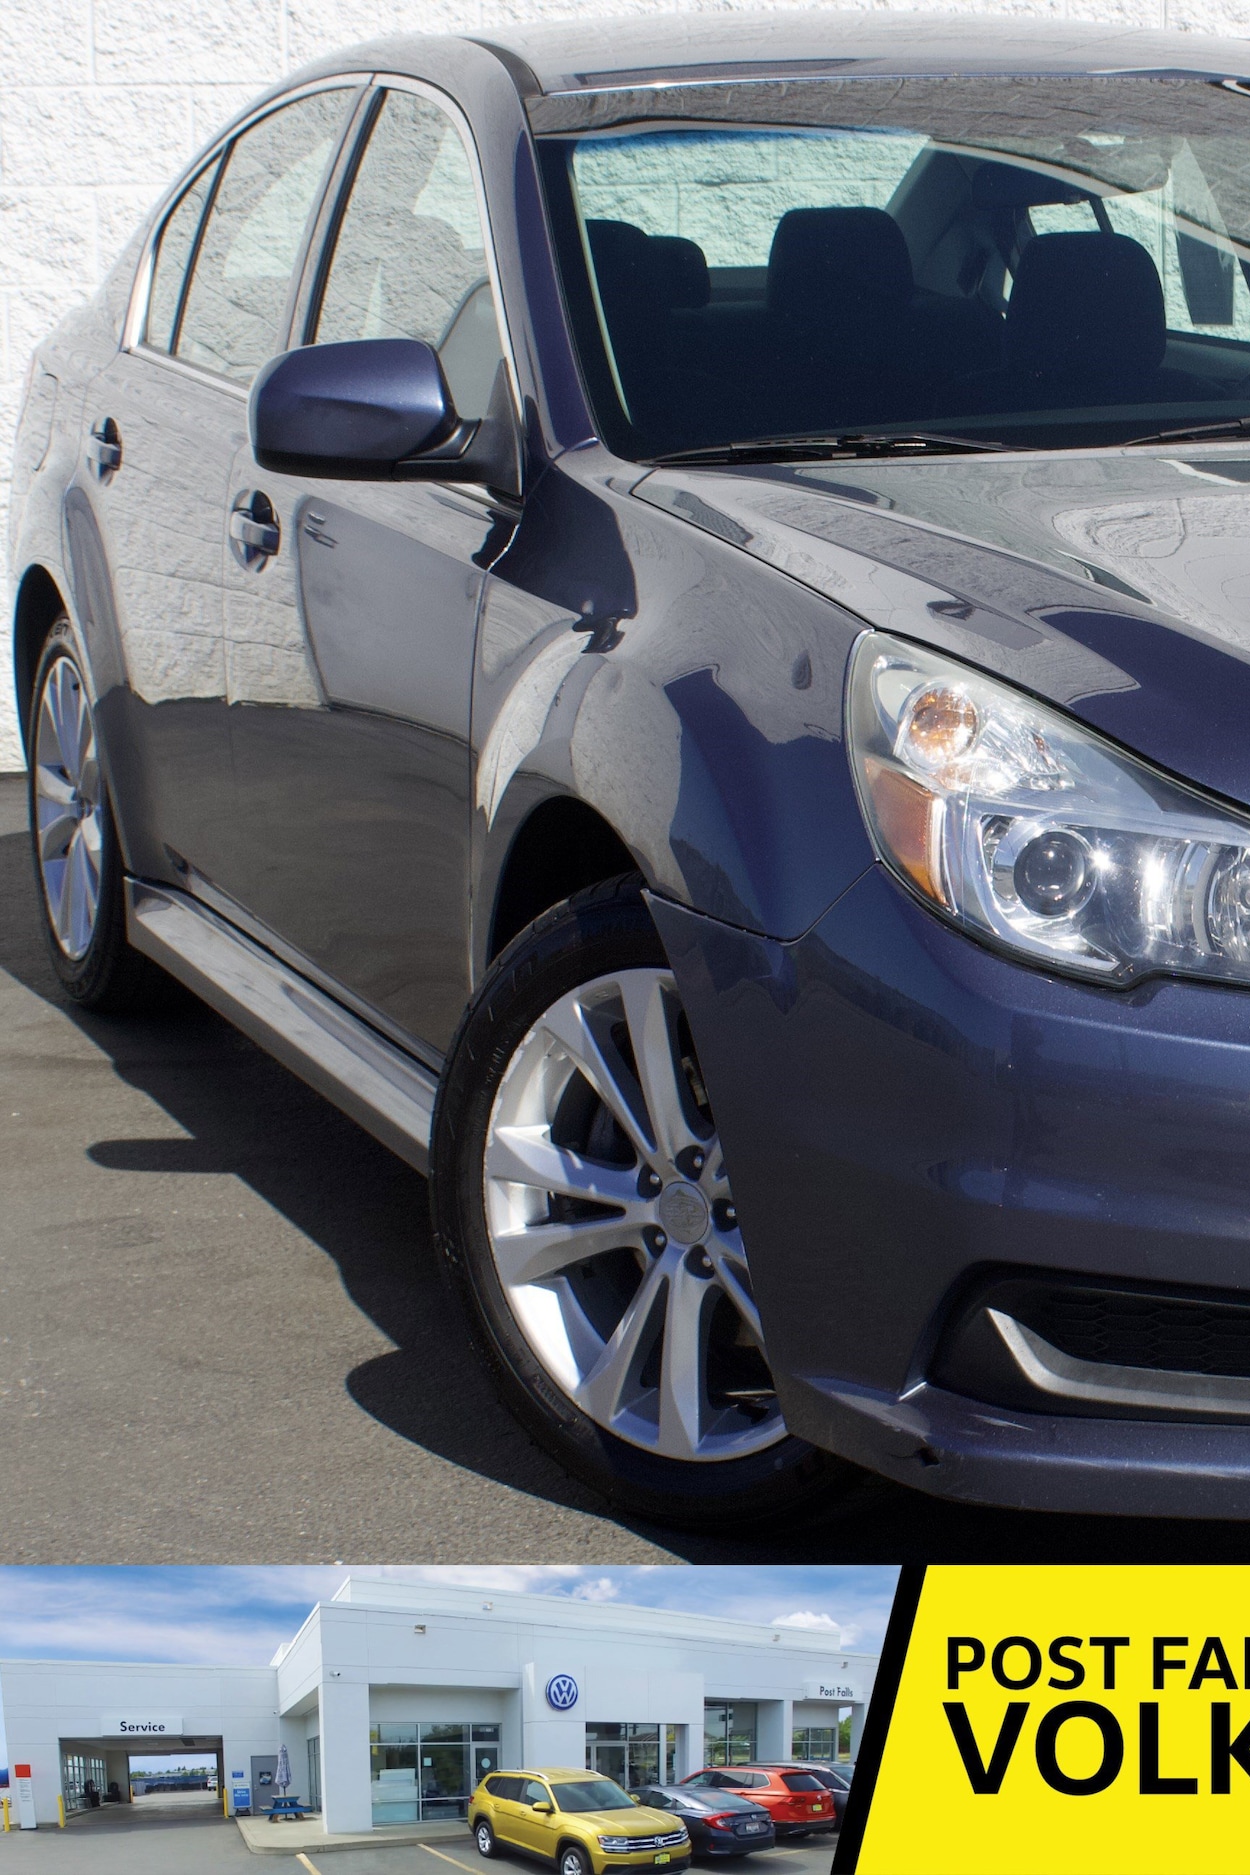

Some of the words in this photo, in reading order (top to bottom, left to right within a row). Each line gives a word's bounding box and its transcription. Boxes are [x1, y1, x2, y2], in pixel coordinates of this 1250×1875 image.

[819, 1685, 835, 1697] Post
[836, 1686, 854, 1698] Falls
[119, 1720, 166, 1732] Service
